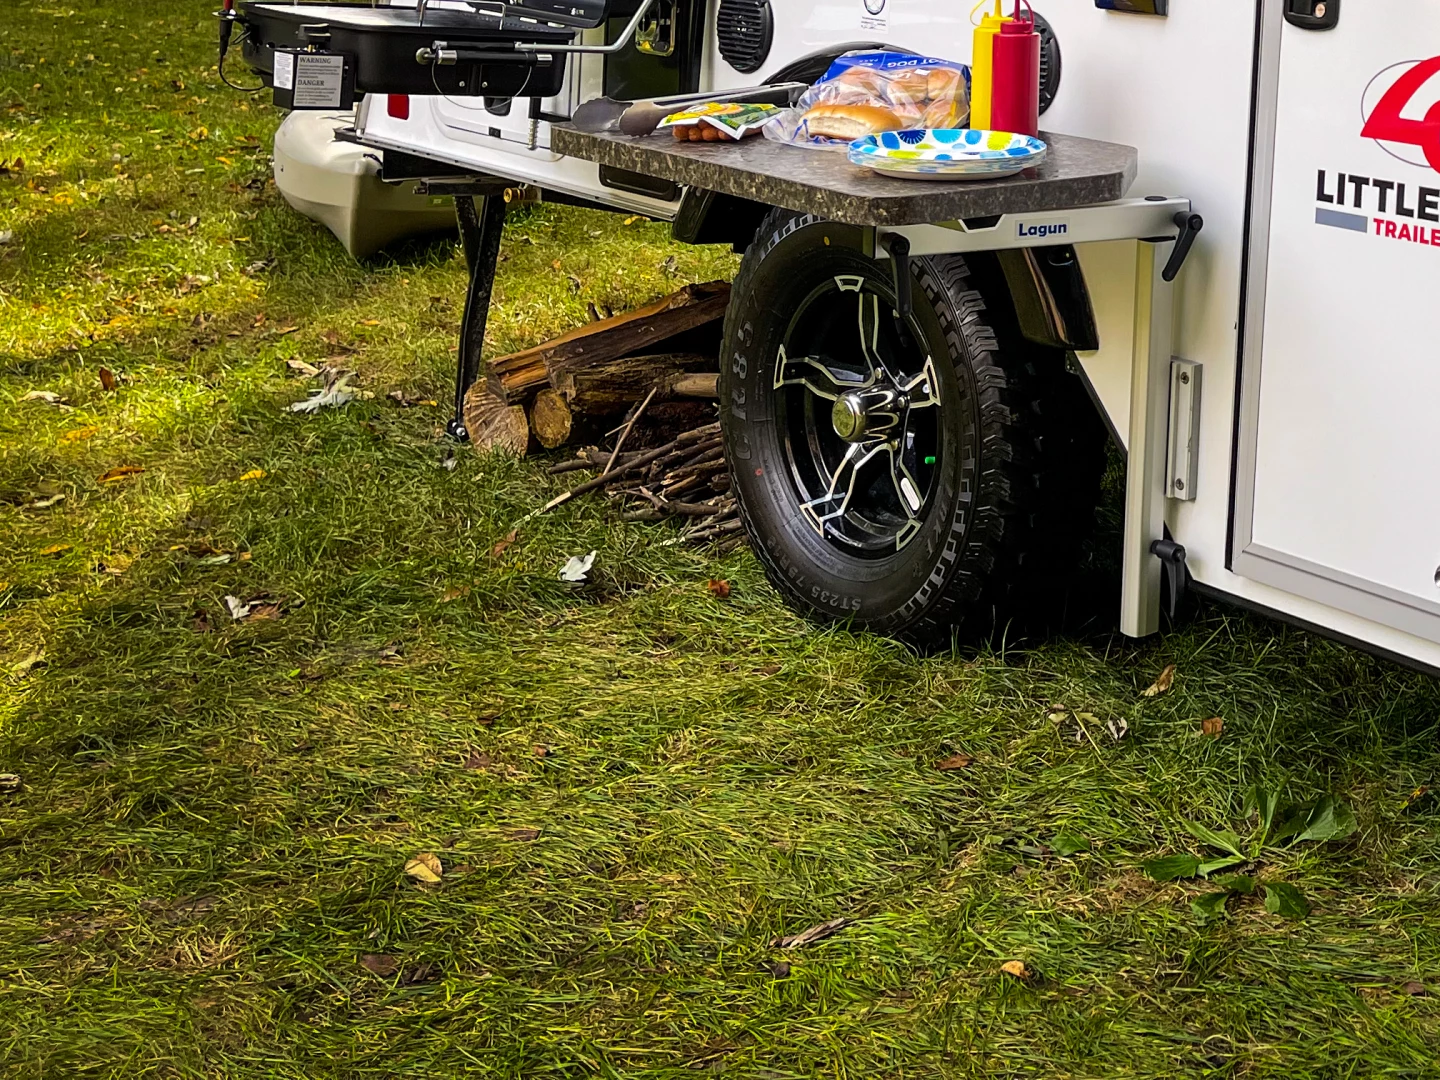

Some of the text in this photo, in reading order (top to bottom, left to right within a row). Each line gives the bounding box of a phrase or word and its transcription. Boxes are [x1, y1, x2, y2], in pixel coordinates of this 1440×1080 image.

[299, 56, 332, 64] WARNING
[1316, 169, 1440, 222] LITTLE
[1018, 223, 1067, 237] Lagun
